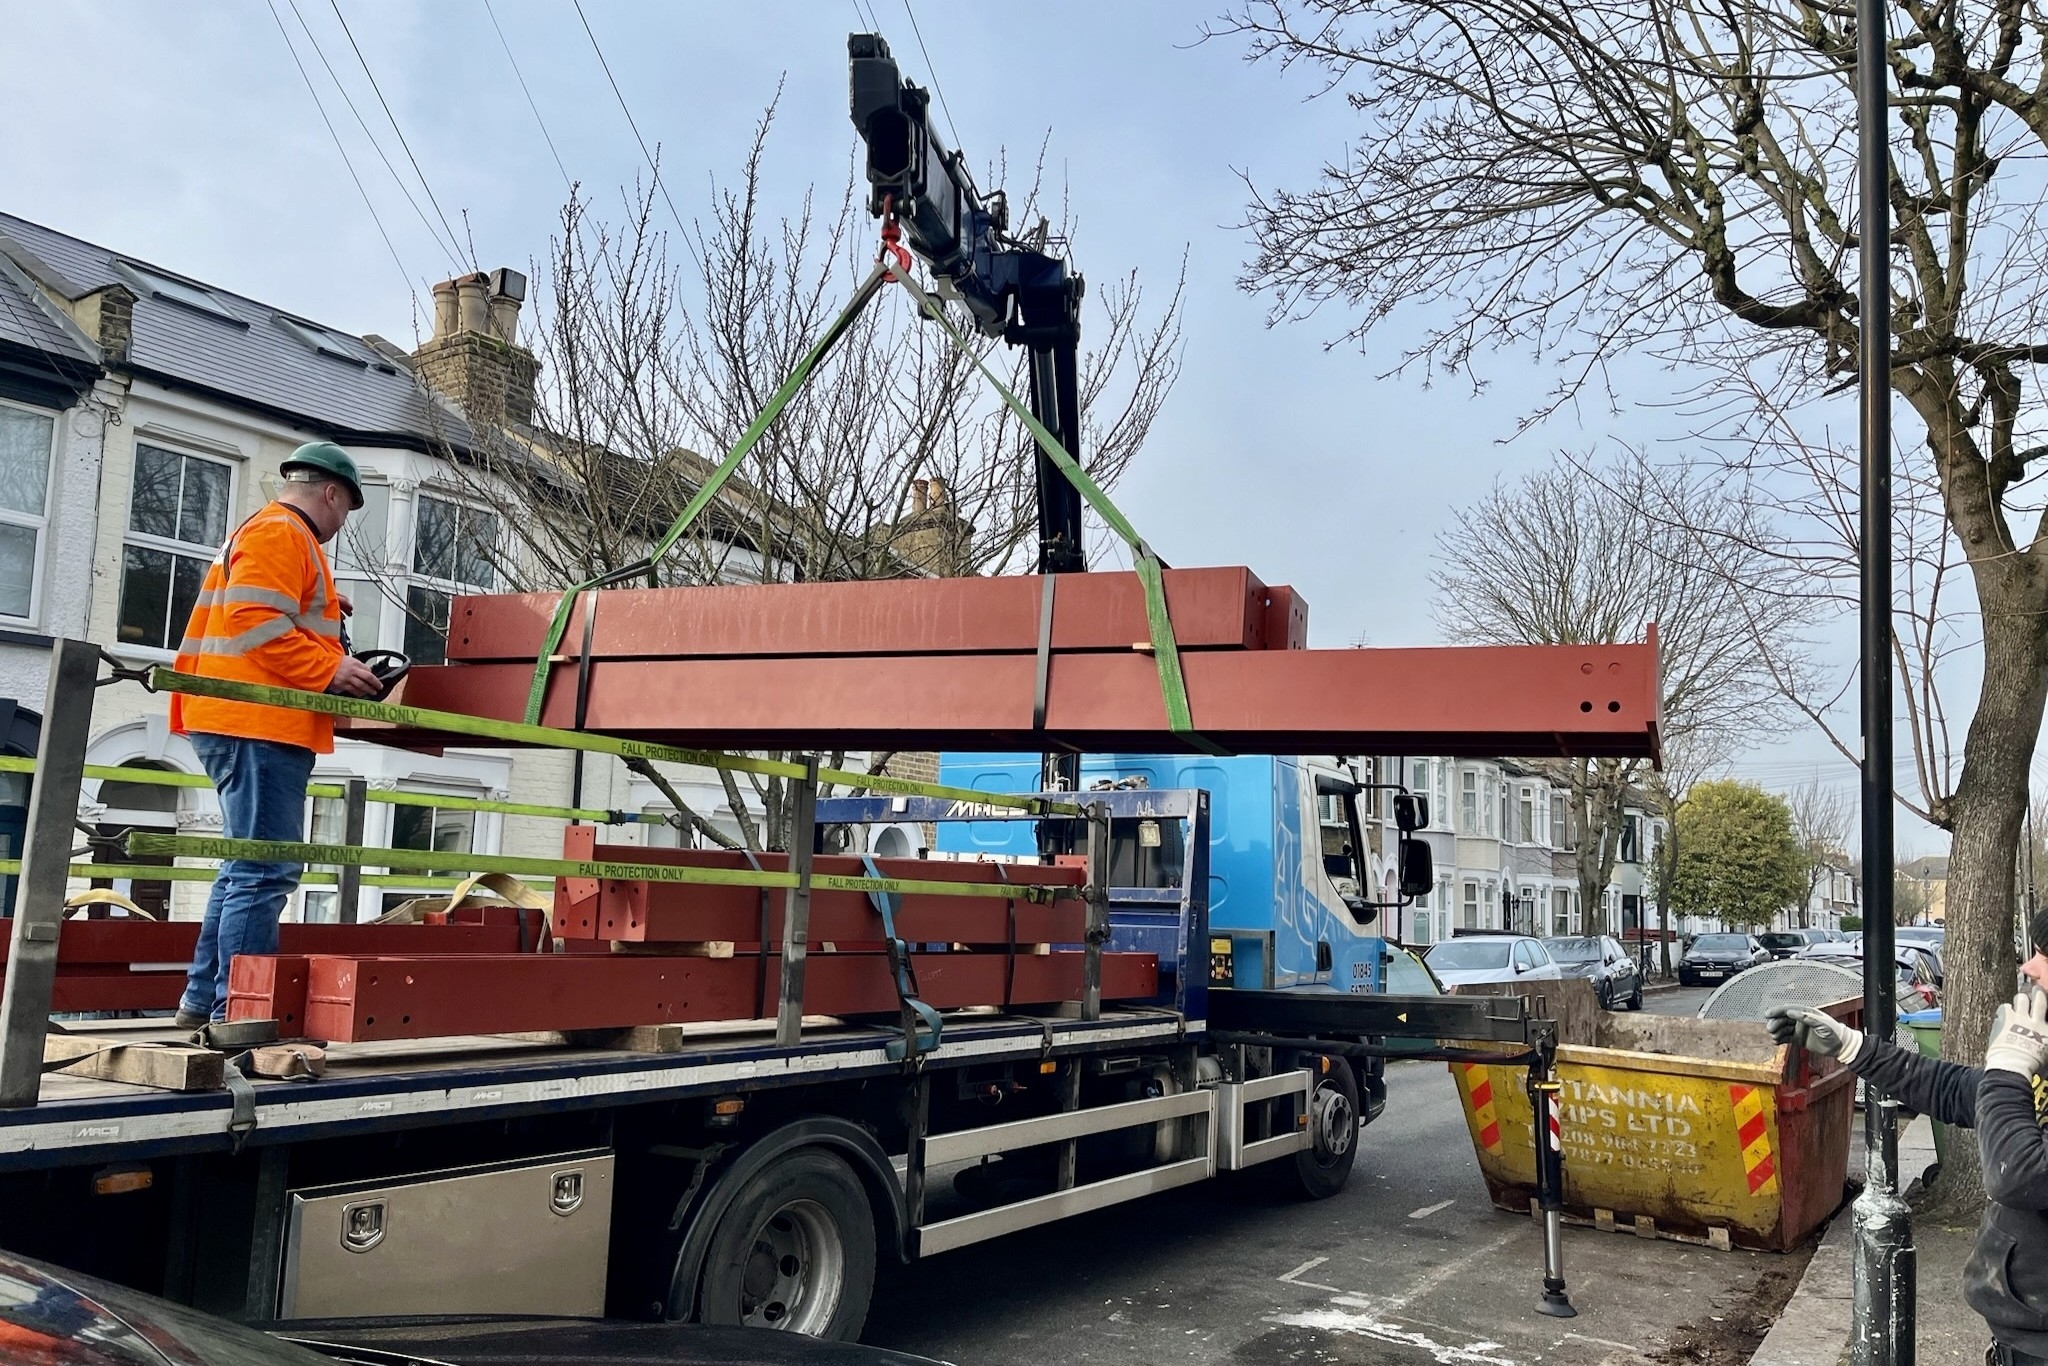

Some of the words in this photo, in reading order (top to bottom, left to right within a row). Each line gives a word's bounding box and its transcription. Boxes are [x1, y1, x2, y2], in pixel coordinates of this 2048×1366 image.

[305, 694, 386, 719] PROTECTION
[388, 706, 420, 724] ONLY
[621, 742, 643, 756] FALL
[645, 745, 698, 763] PROTECTION
[698, 753, 720, 766] ONLY
[856, 775, 872, 787] FALL
[872, 778, 909, 793] PROTECTION
[909, 783, 925, 794] ONLY
[200, 840, 236, 857] FALL
[240, 842, 326, 862] PROTECTION
[329, 848, 365, 863] ONLY
[579, 863, 602, 877] FALL
[604, 864, 660, 880] PROTECTION
[661, 867, 684, 880] ONLY
[828, 877, 844, 889] FALL
[845, 878, 884, 890] PROTECTION
[884, 880, 900, 891] ONLY
[1352, 962, 1372, 979] 01845
[76, 1125, 120, 1138] MACS
[1627, 1112, 1692, 1138] LTD
